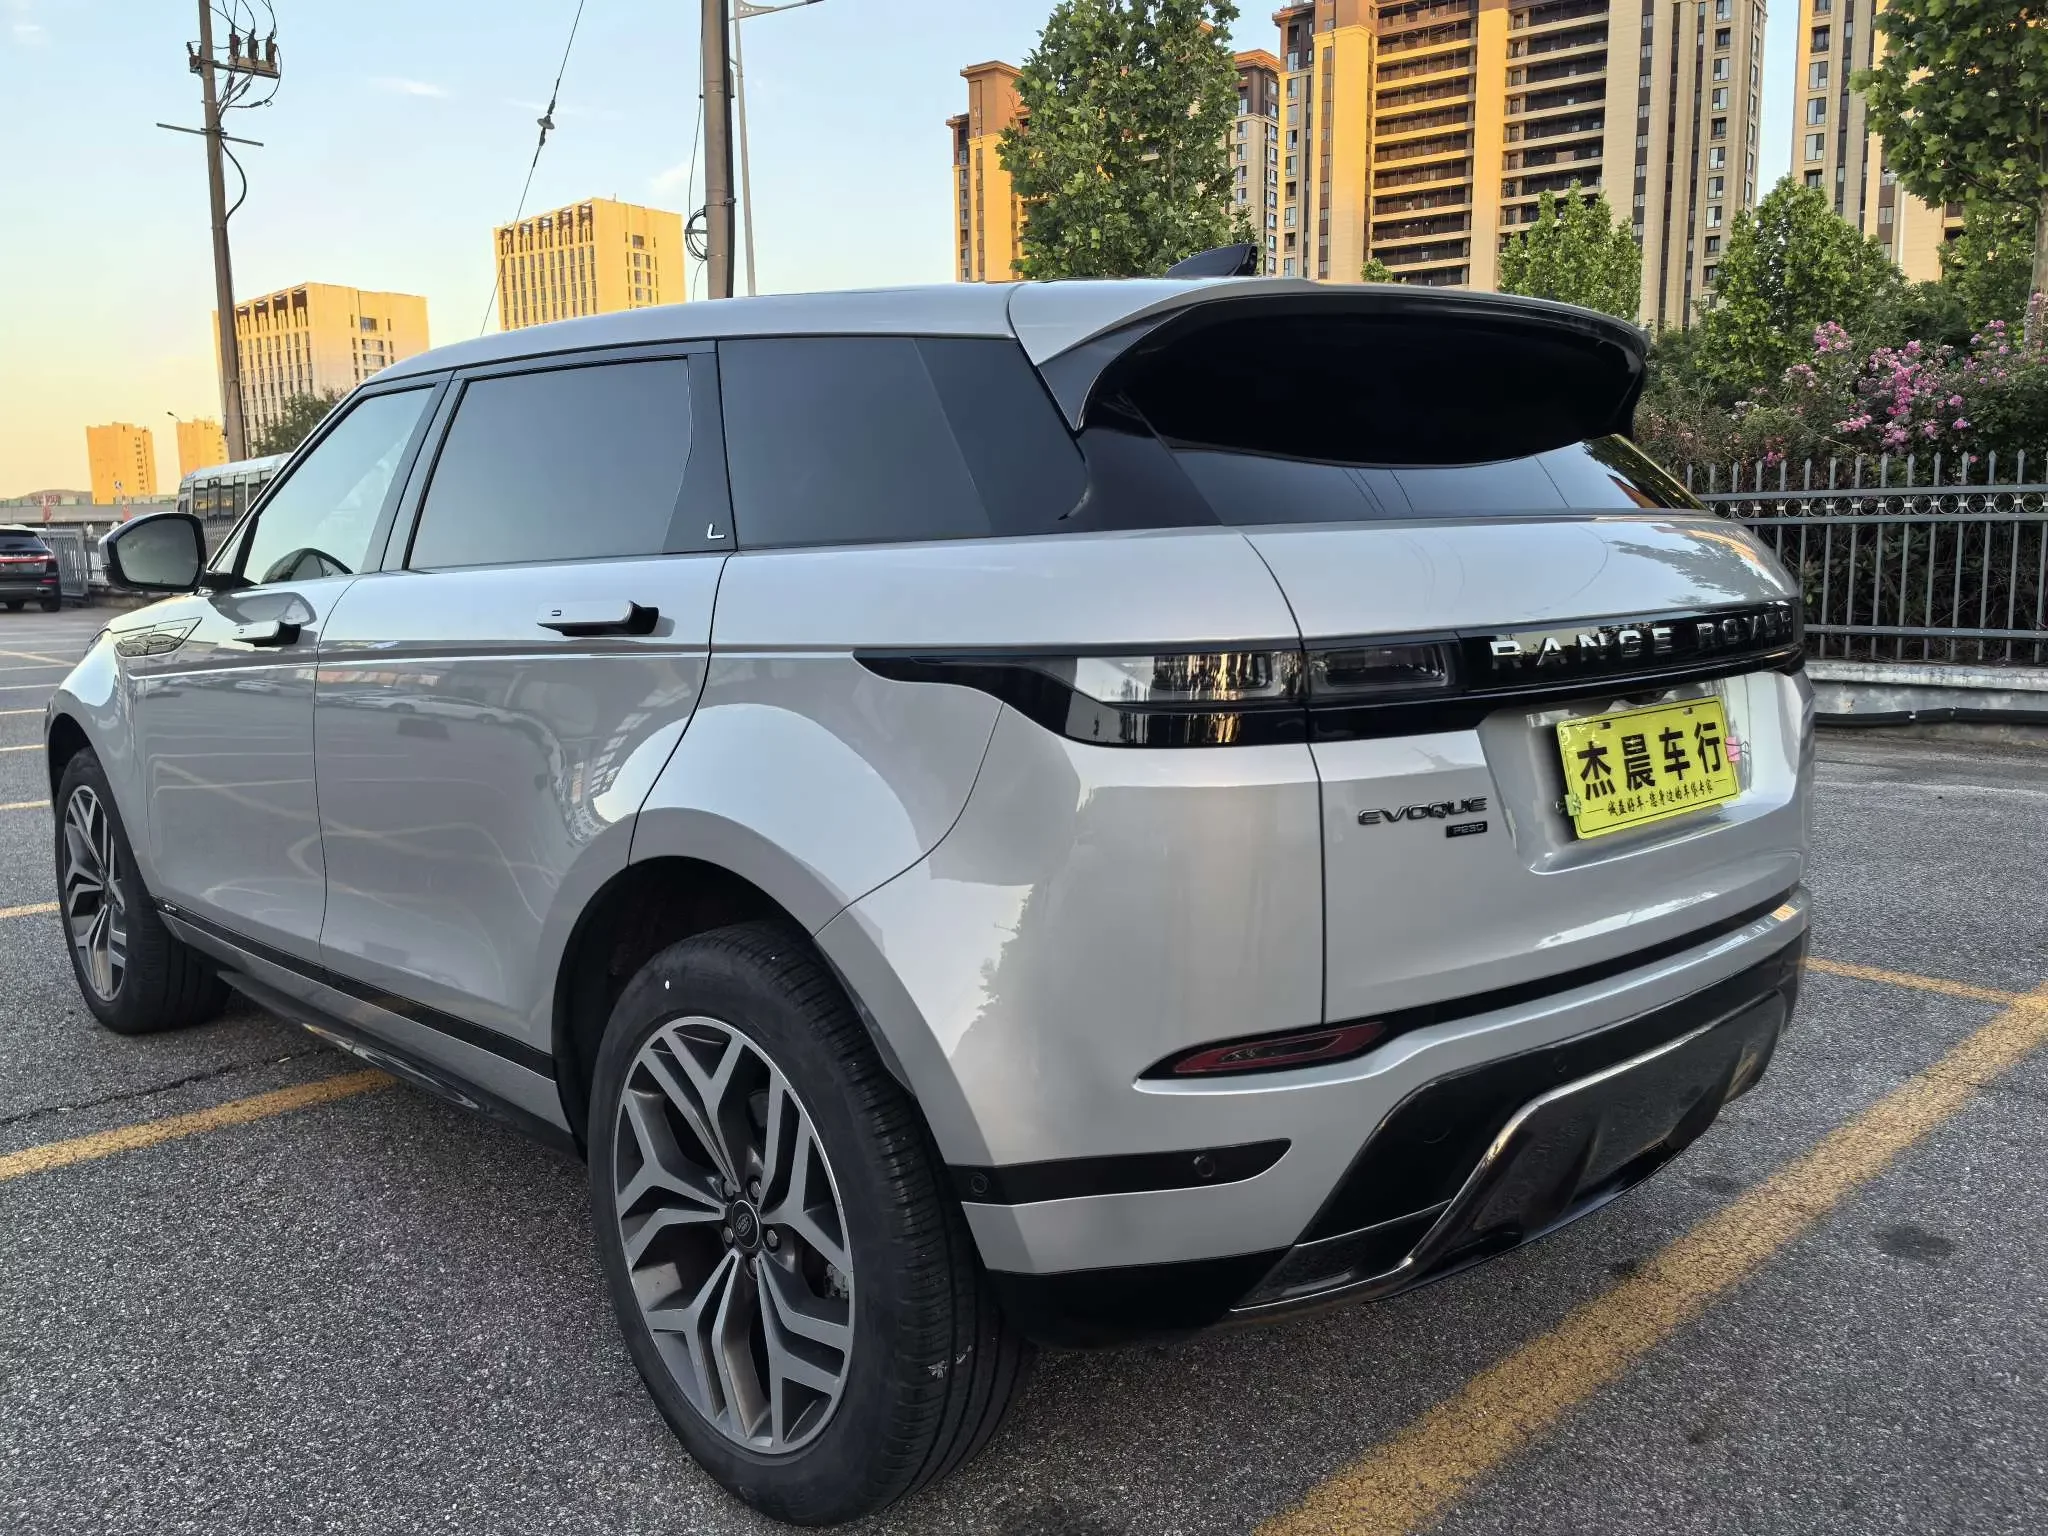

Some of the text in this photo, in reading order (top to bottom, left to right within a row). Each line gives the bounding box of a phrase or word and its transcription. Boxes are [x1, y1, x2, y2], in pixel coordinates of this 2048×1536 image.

[1490, 609, 1793, 670] RANGE ROVER
[1577, 721, 1722, 800] 杰晨车行
[1358, 797, 1488, 825] EVOQUE
